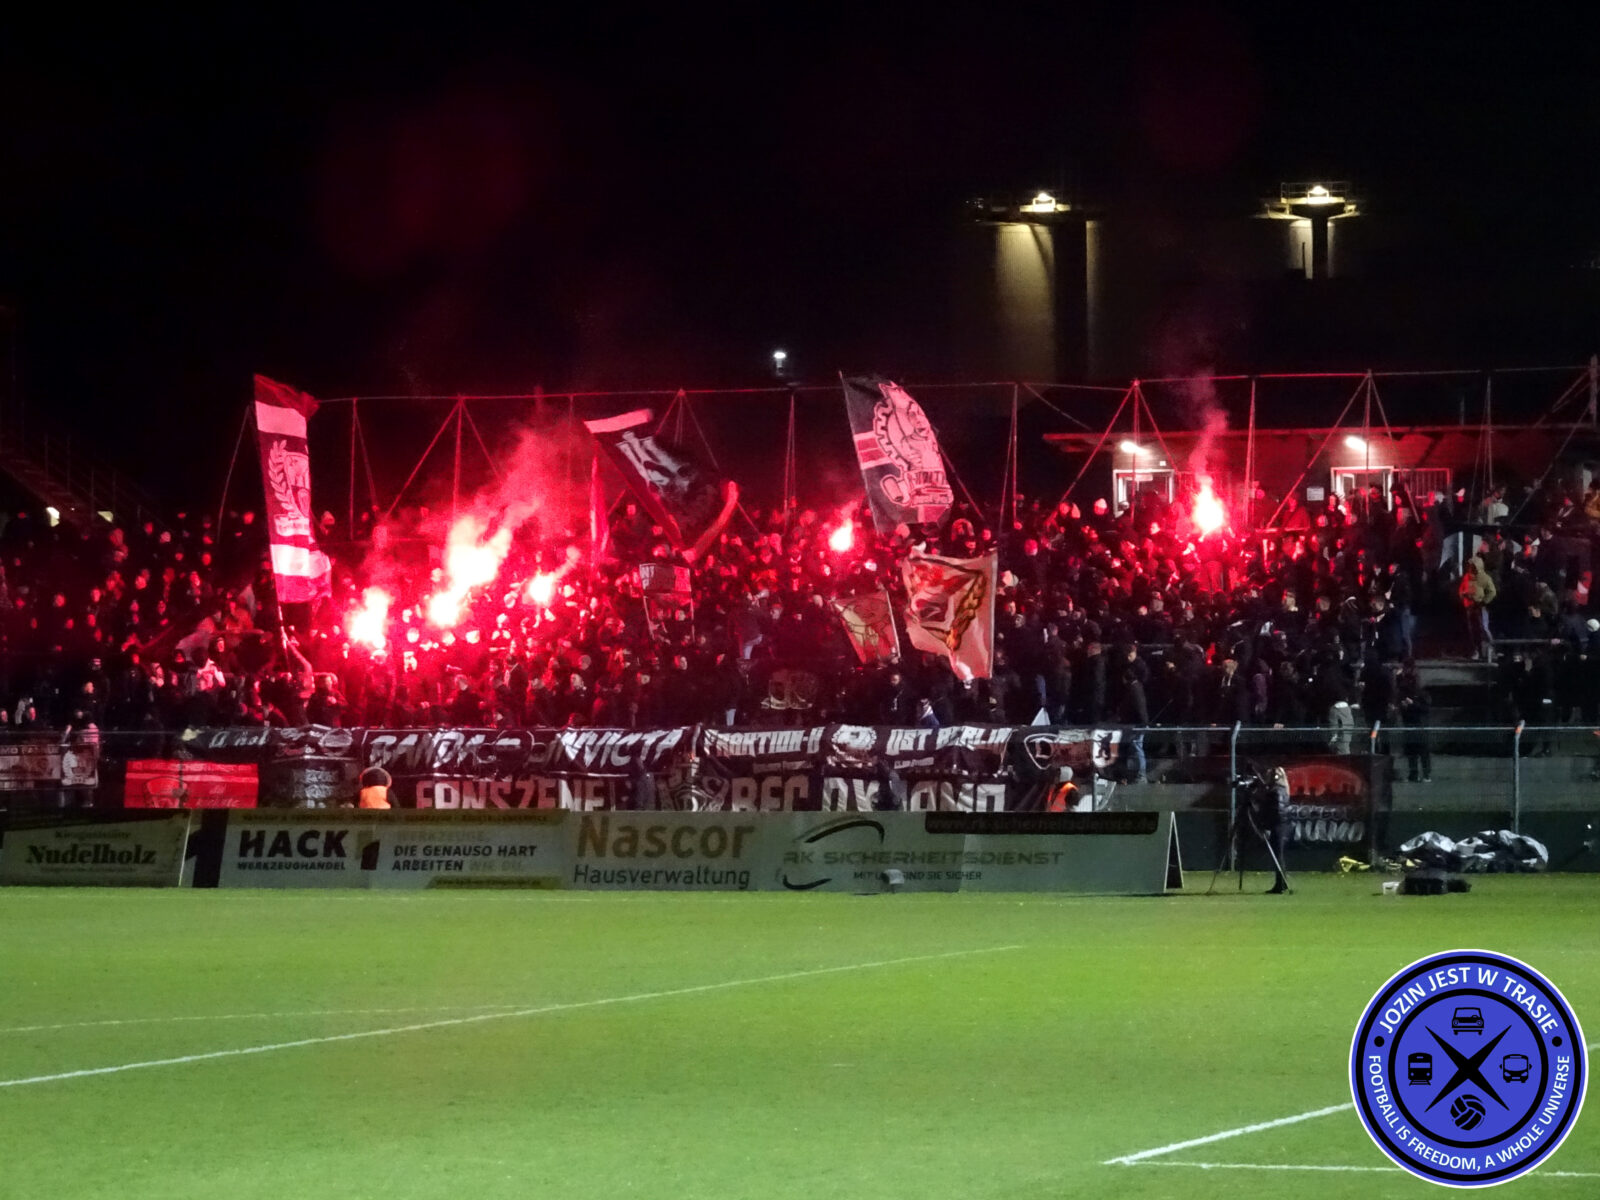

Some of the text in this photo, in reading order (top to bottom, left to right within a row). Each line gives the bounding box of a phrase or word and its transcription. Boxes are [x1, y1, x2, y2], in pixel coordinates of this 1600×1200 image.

[885, 729, 933, 756] OST
[239, 830, 349, 858] HACK
[576, 815, 755, 859] Nascor
[26, 843, 157, 864] Nudelholz
[394, 845, 537, 857] DIE GENAUSO HART
[783, 850, 1064, 866] RK SICHERHEITSDIENST
[238, 861, 346, 870] WERKZEUGHANDEL
[392, 860, 464, 871] ARBEITEN
[573, 864, 751, 890] Hausverwaltung
[854, 871, 872, 880] MIT
[927, 871, 942, 880] SIE
[946, 871, 982, 880] SICHER
